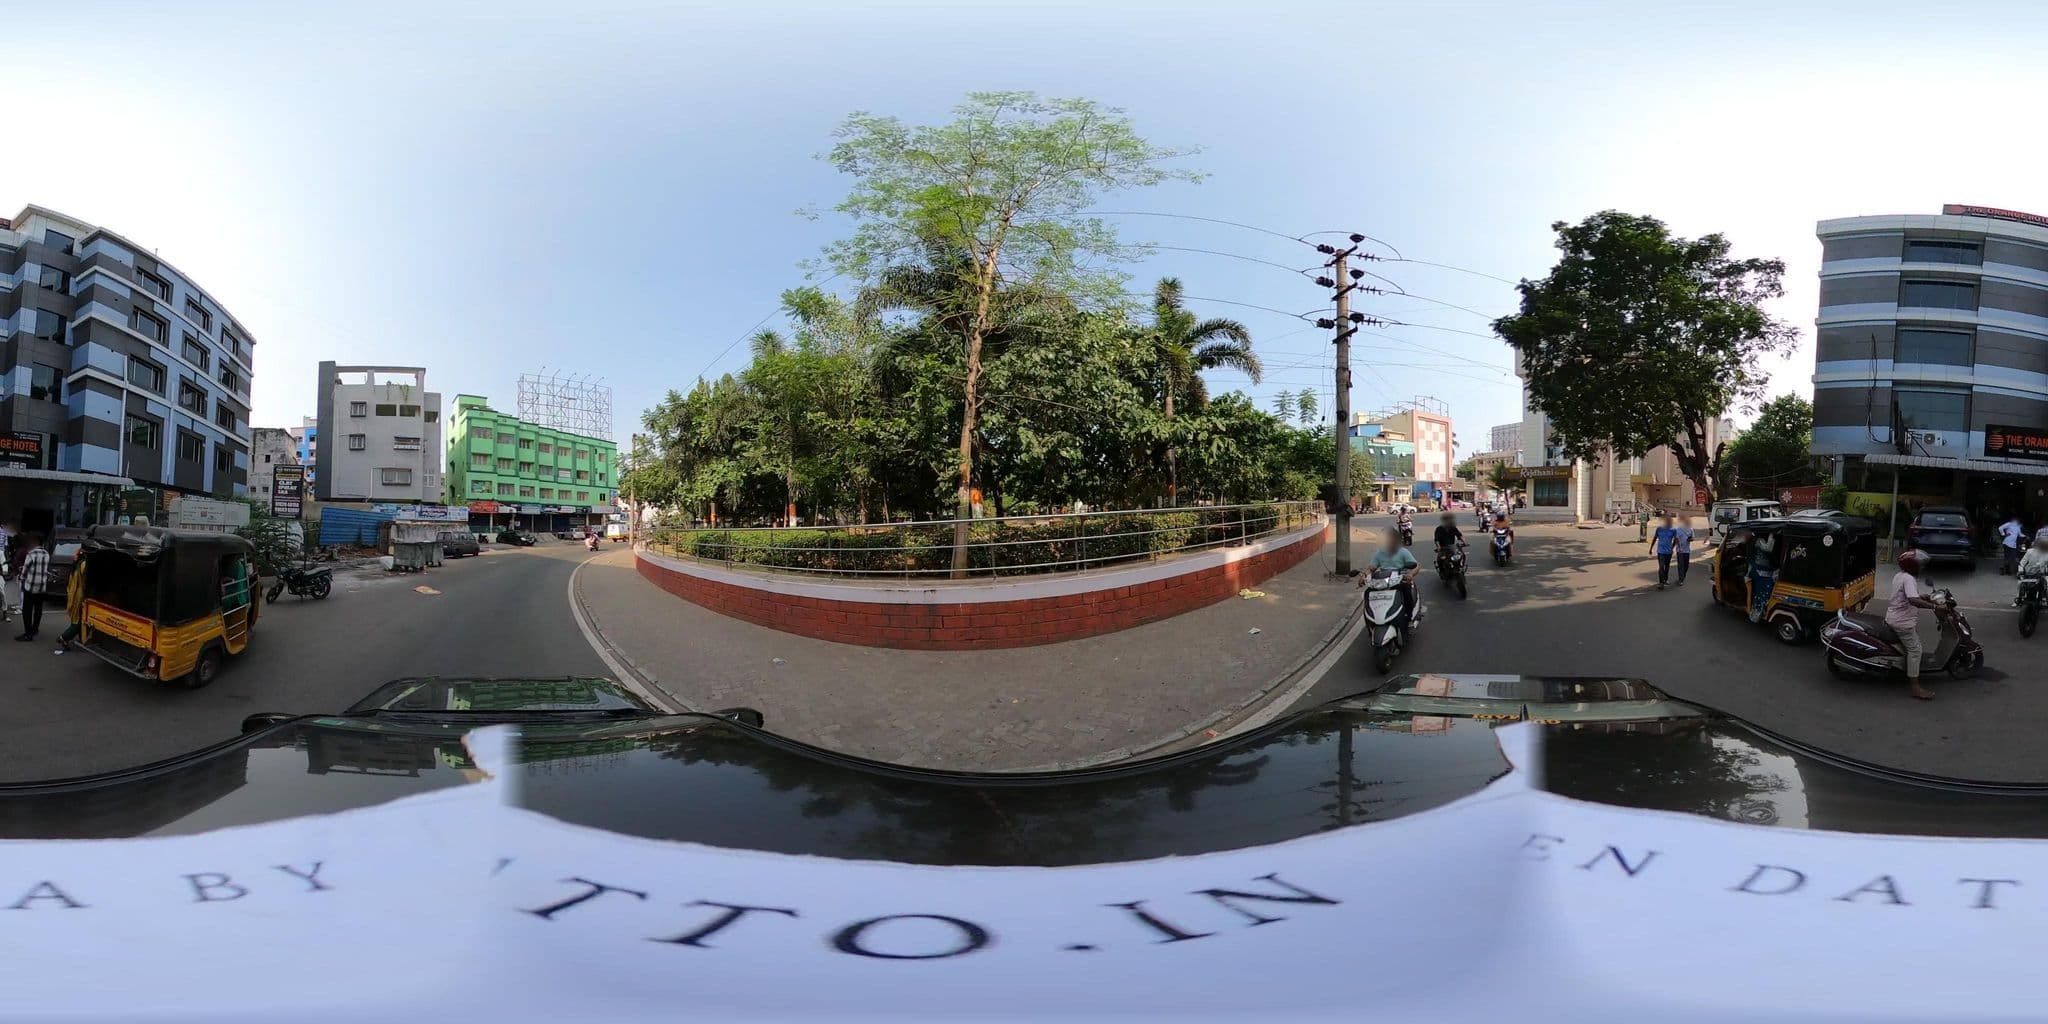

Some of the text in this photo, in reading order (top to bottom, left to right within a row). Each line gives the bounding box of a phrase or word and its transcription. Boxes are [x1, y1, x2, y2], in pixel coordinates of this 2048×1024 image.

[0, 438, 40, 453] GE HOTEL
[2006, 435, 2023, 446] THE
[6, 860, 334, 911] A BY
[494, 857, 1345, 961] TTO.IN
[1727, 863, 2022, 910] DAT
